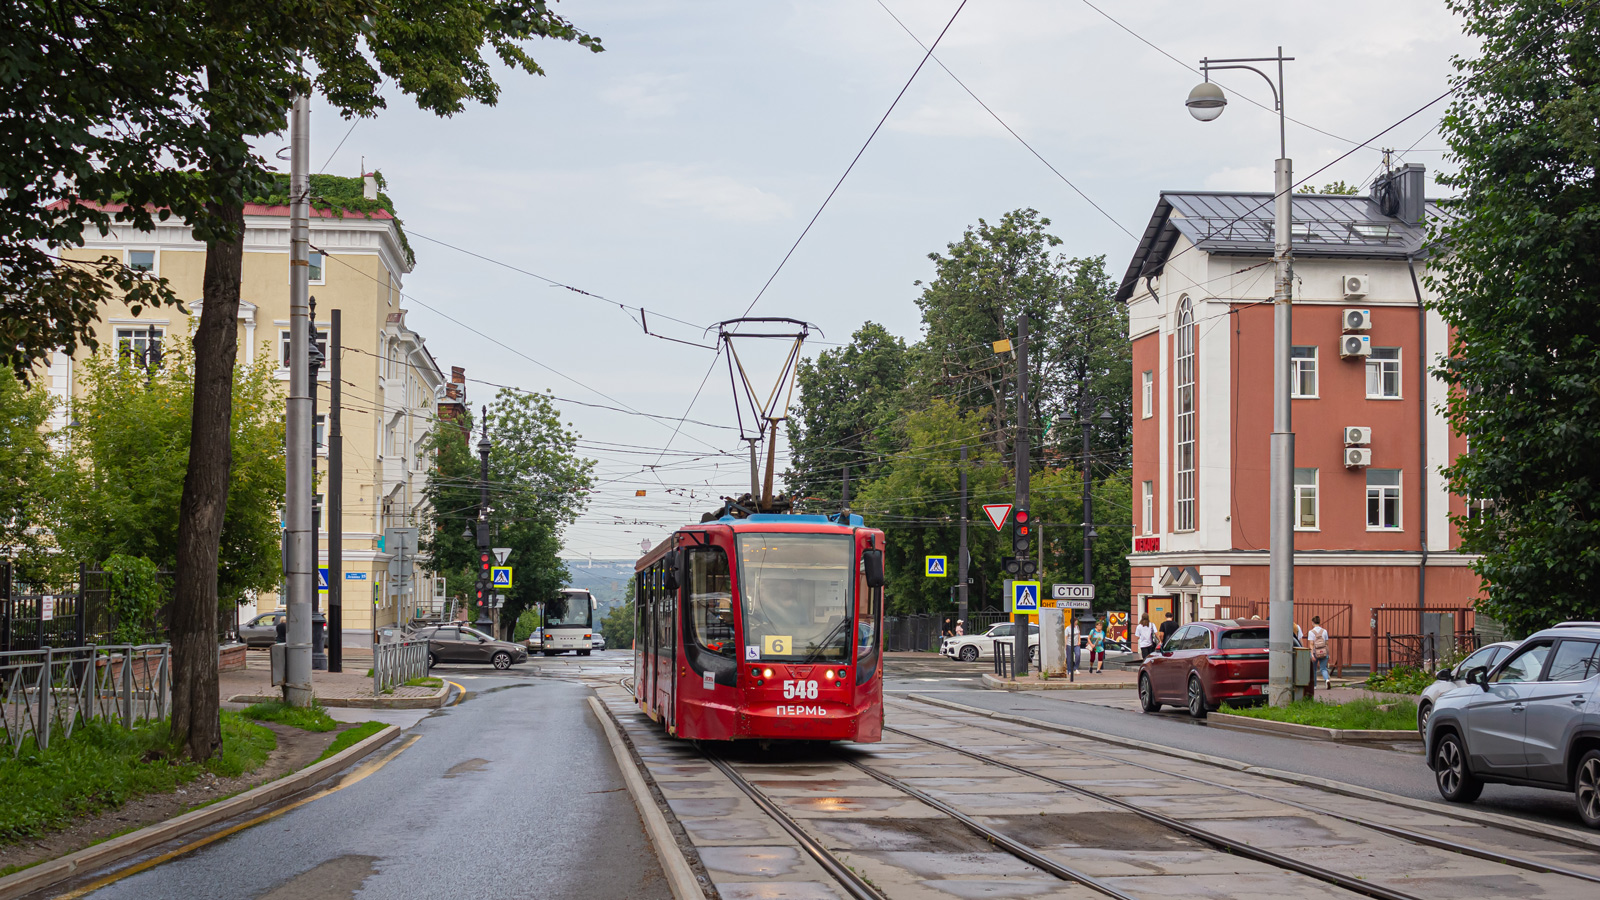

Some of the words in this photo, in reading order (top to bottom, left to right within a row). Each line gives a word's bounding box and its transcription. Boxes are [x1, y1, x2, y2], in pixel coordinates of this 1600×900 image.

[1058, 587, 1089, 596] СТОП
[772, 639, 784, 653] 6
[783, 680, 819, 699] 548
[776, 705, 827, 716] ПЕРМЬ
